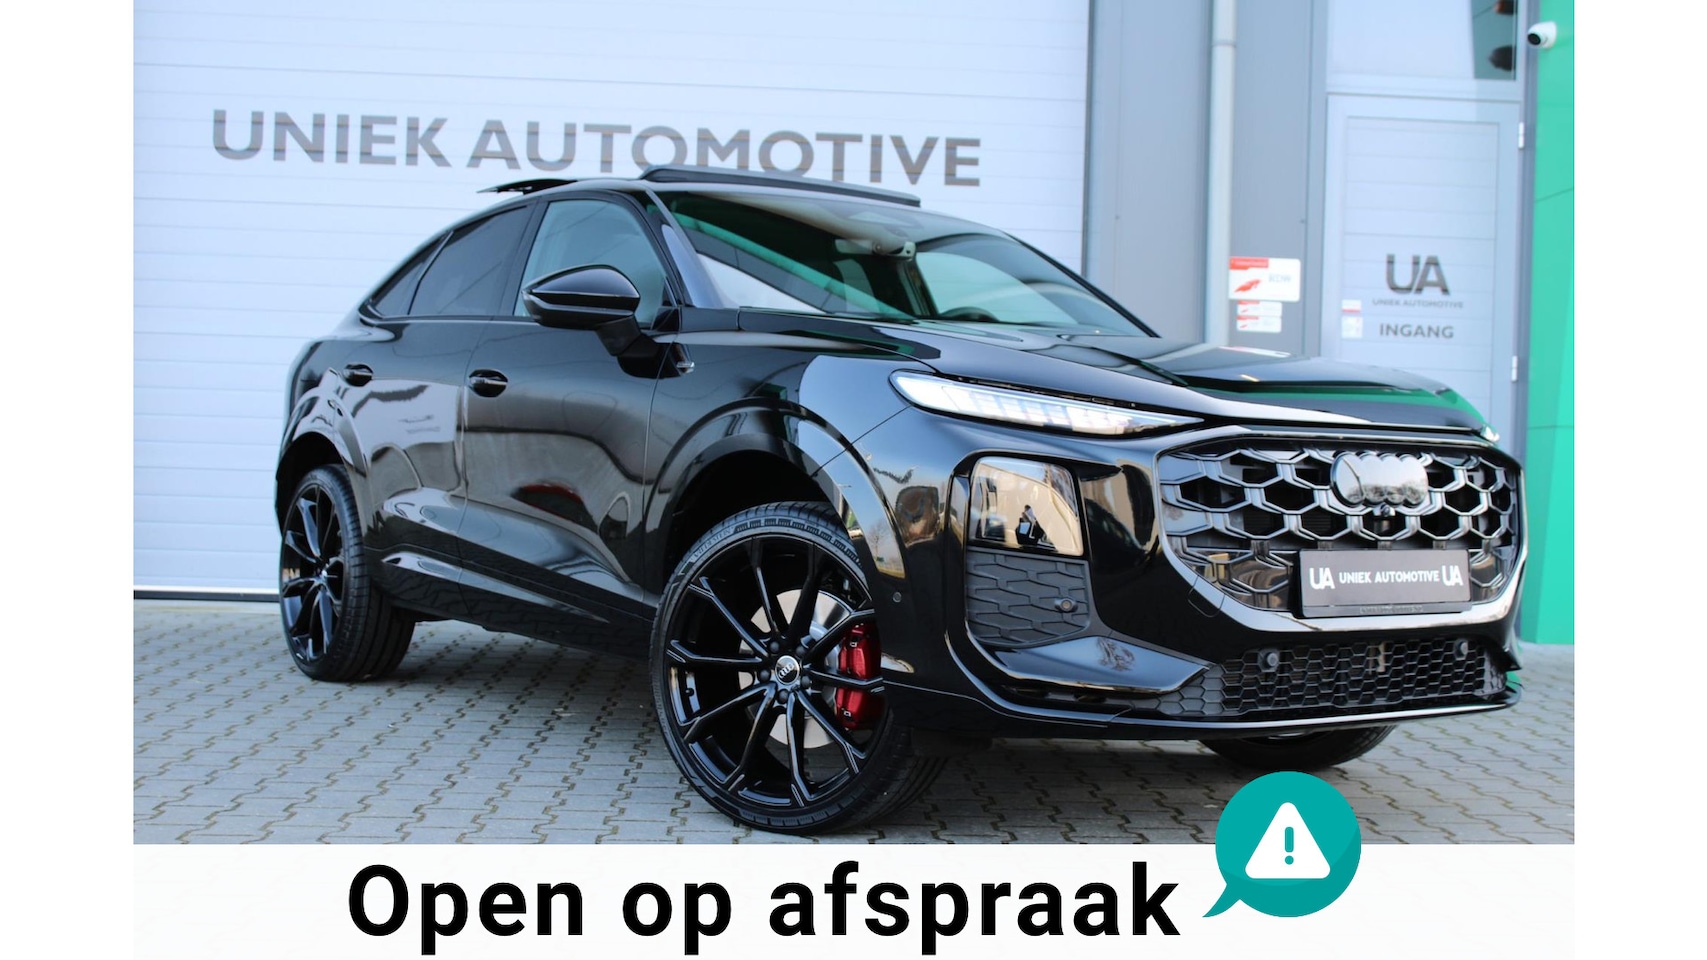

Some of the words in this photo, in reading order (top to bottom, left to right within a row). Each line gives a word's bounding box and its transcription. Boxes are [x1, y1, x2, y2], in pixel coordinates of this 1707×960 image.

[212, 109, 452, 168] UNIEK
[466, 119, 981, 187] AUTOMOTIVE
[1386, 253, 1450, 296] UA
[1372, 298, 1401, 306] UNIEK
[1402, 299, 1464, 309] AUTOMOTIVE
[1380, 323, 1454, 339] INGANG
[1309, 567, 1335, 590] UA
[1339, 571, 1372, 584] UNIEK
[1374, 570, 1440, 583] AUTOMOTIVE
[1441, 565, 1464, 587] UA
